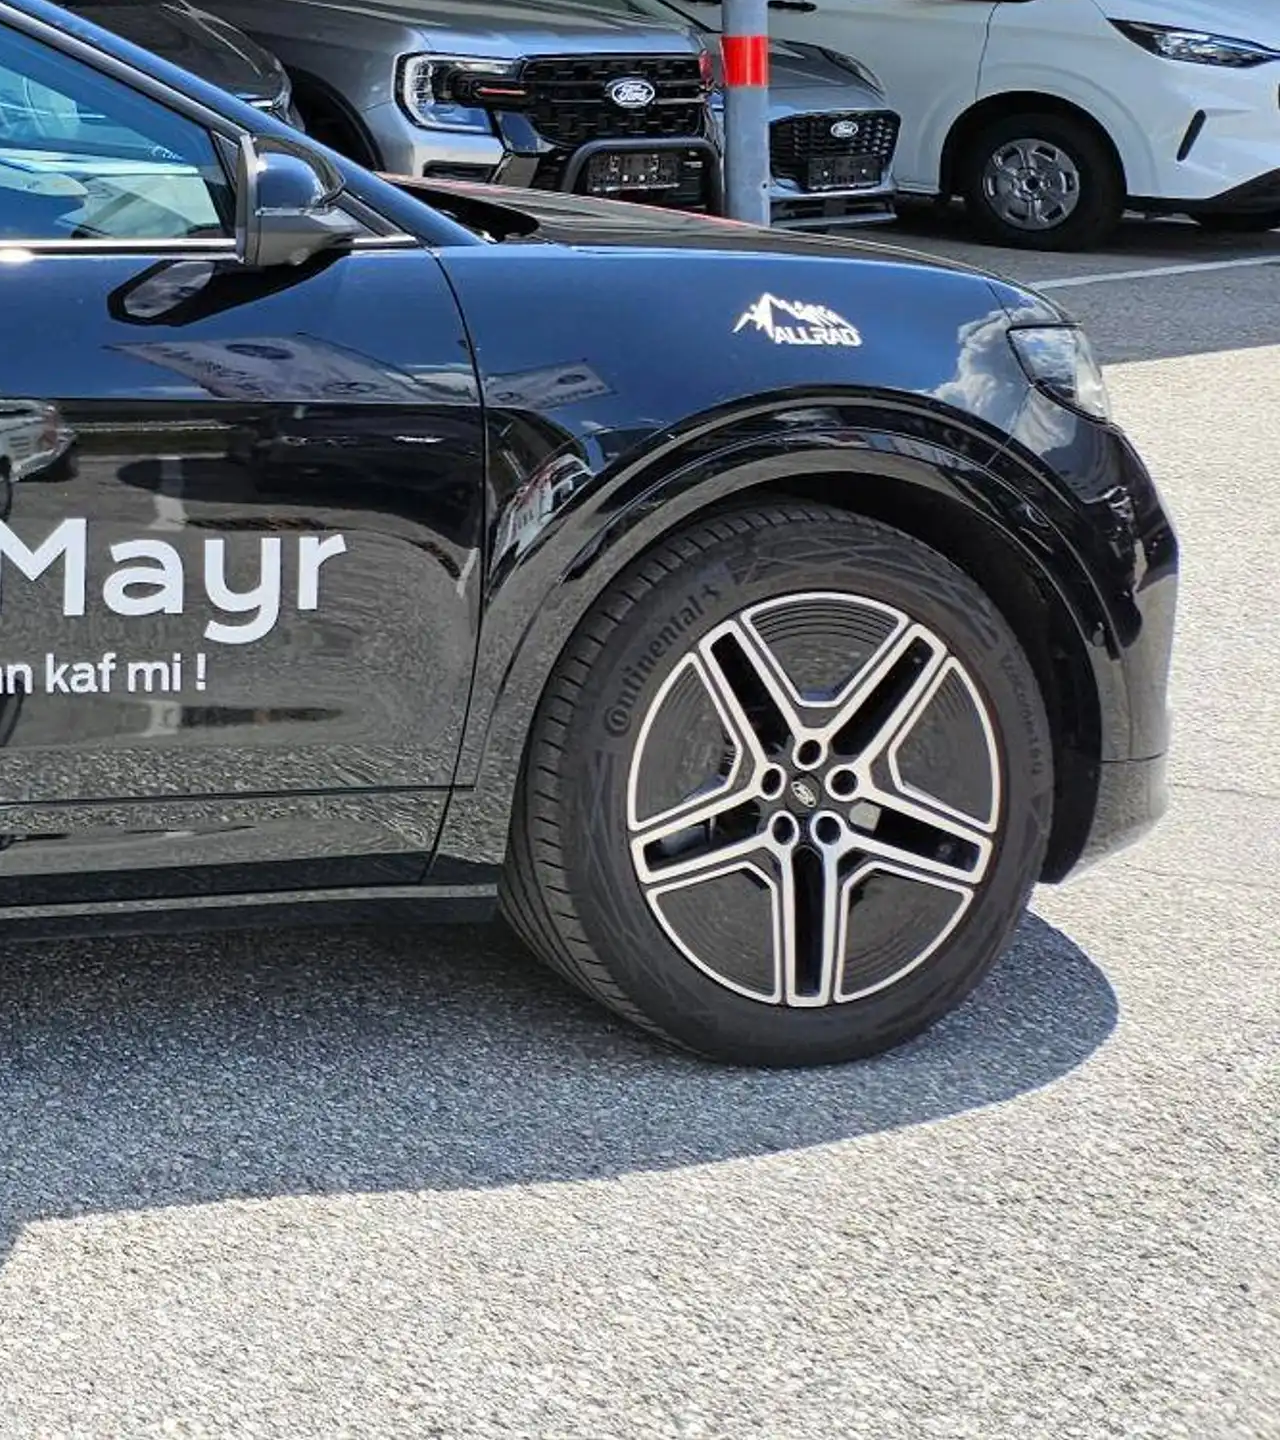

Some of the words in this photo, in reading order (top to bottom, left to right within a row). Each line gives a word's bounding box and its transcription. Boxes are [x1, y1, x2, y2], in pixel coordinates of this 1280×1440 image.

[774, 326, 862, 346] ALLRAD
[44, 652, 116, 693] kaf
[127, 653, 182, 692] mi
